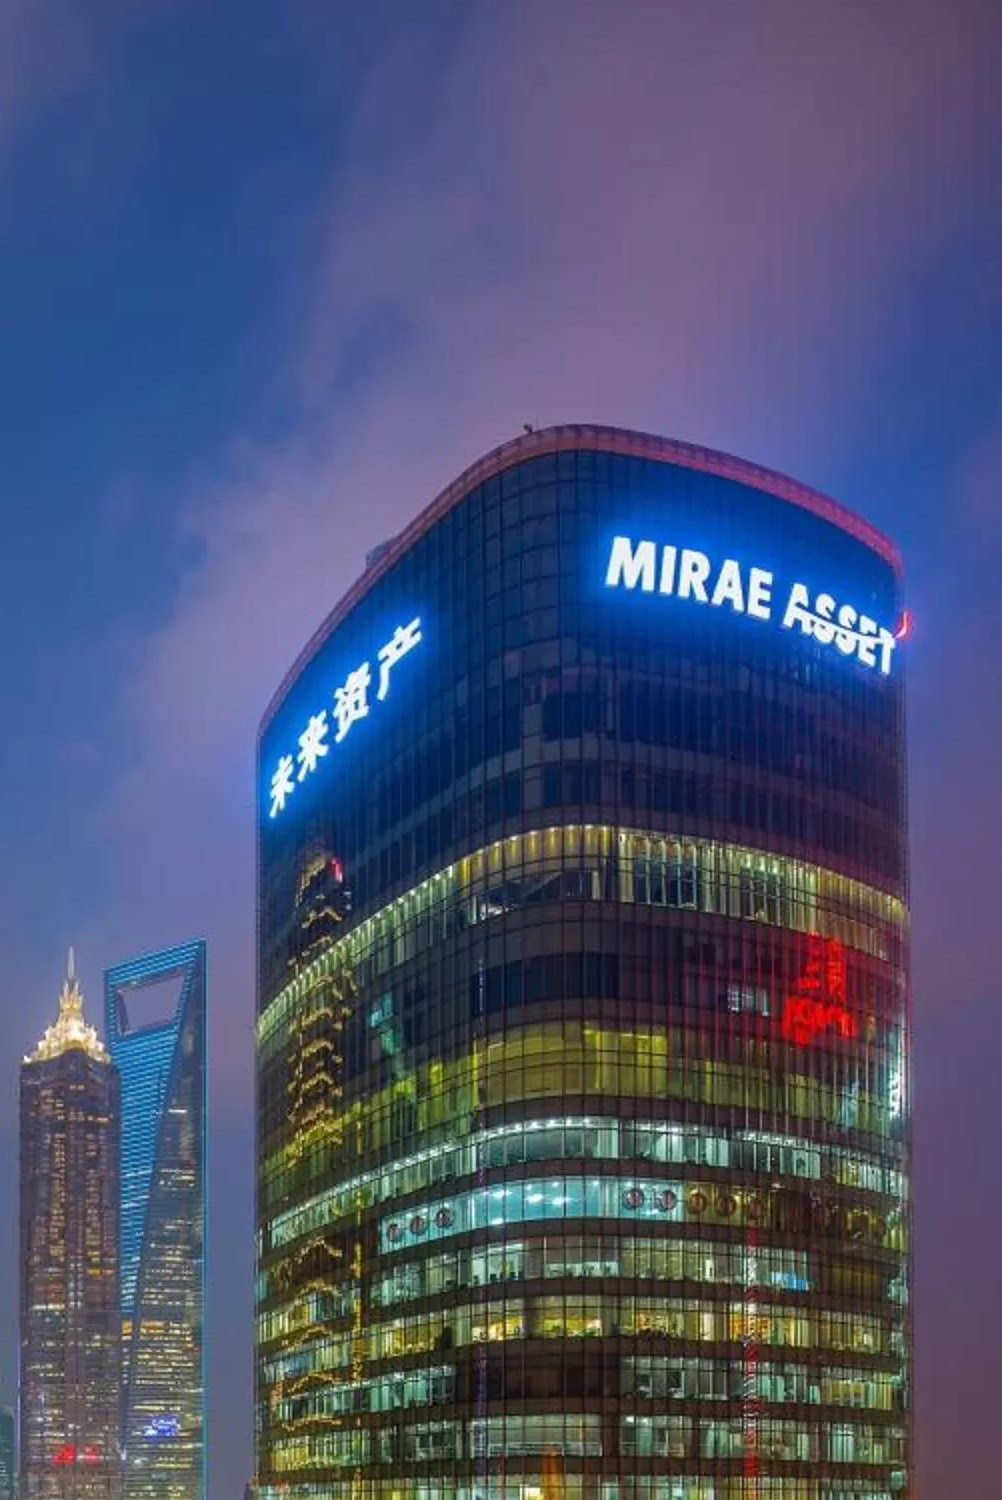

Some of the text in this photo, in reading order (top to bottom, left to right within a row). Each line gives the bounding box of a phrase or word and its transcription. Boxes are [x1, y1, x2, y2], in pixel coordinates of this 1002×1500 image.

[605, 536, 895, 675] MIRAE ASSET
[269, 616, 422, 819] 未来资产
